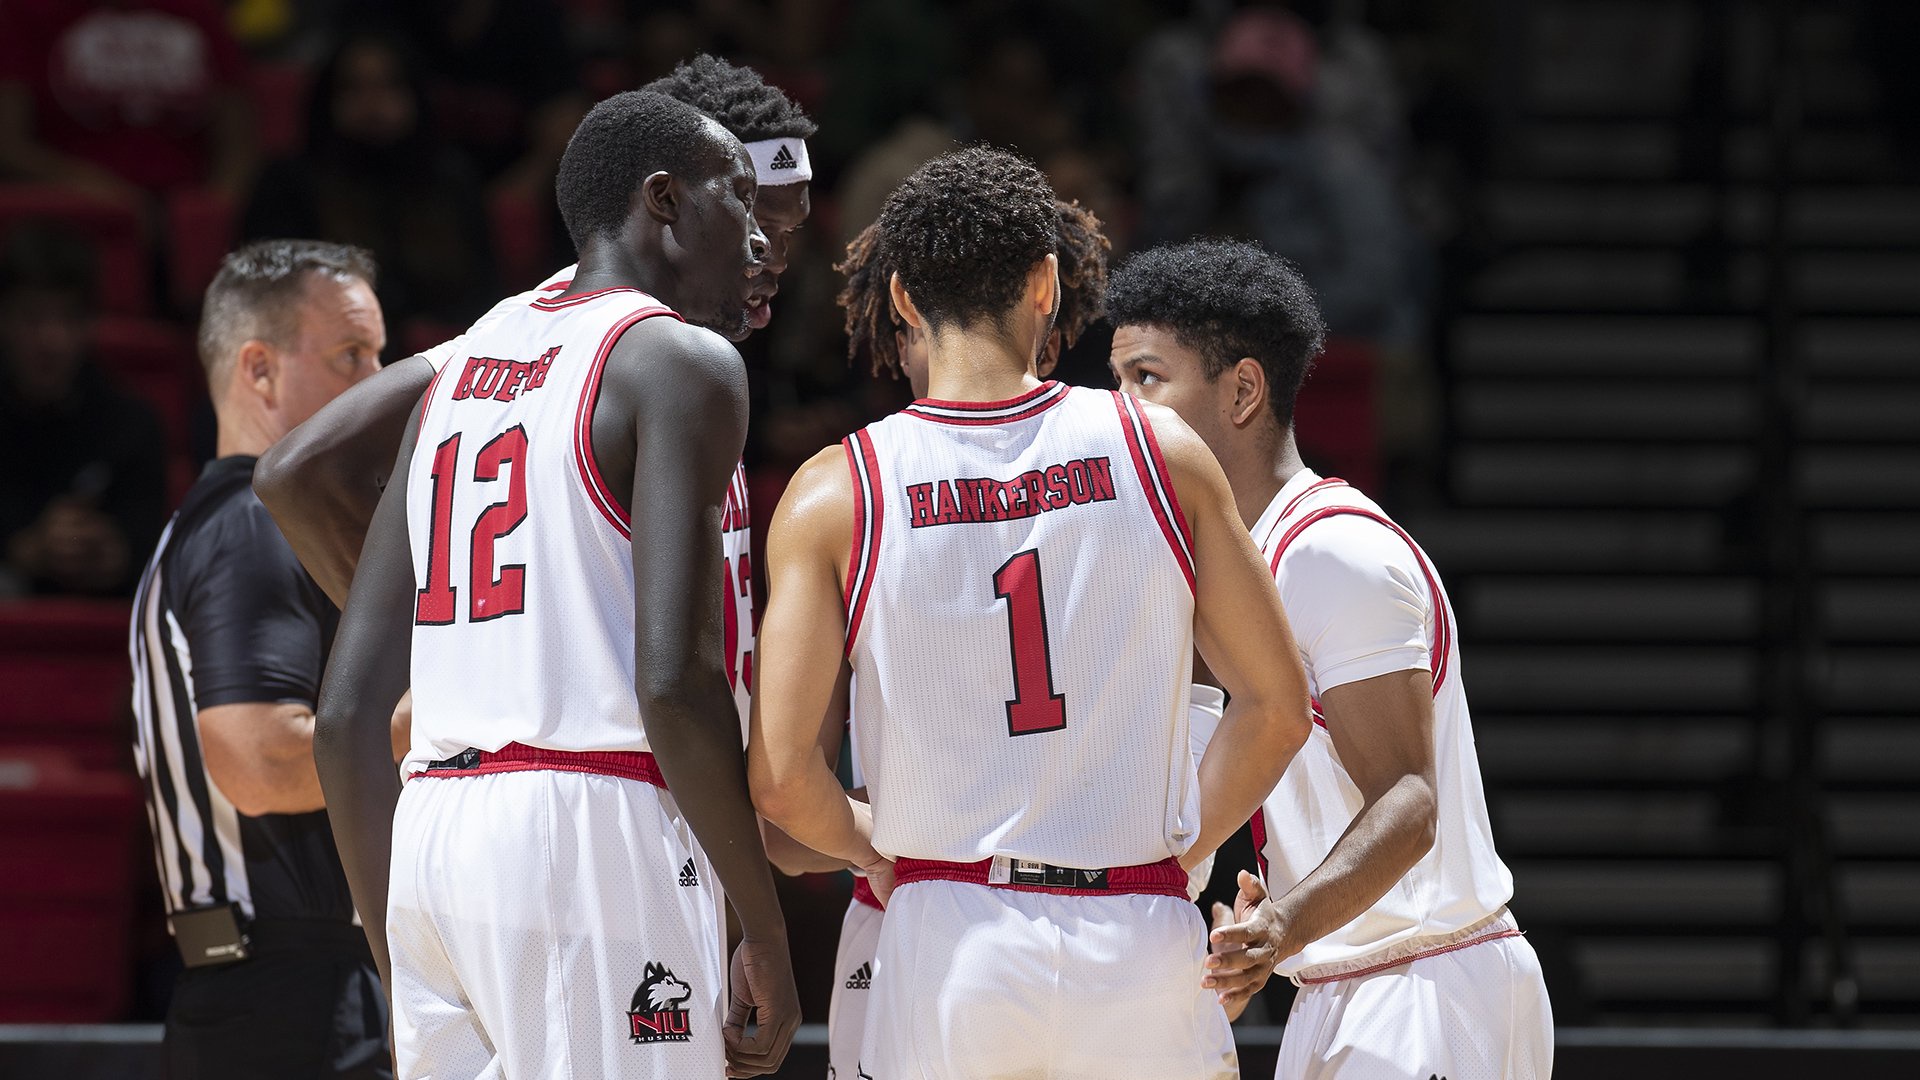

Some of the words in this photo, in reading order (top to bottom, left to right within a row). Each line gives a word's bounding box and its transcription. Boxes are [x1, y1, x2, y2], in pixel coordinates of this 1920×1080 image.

[770, 160, 797, 170] adidas
[906, 456, 1117, 528] HANKERSON
[415, 423, 528, 626] 12
[992, 548, 1067, 737] 1
[631, 1011, 688, 1036] NIU
[638, 1034, 686, 1042] HUSKIES
